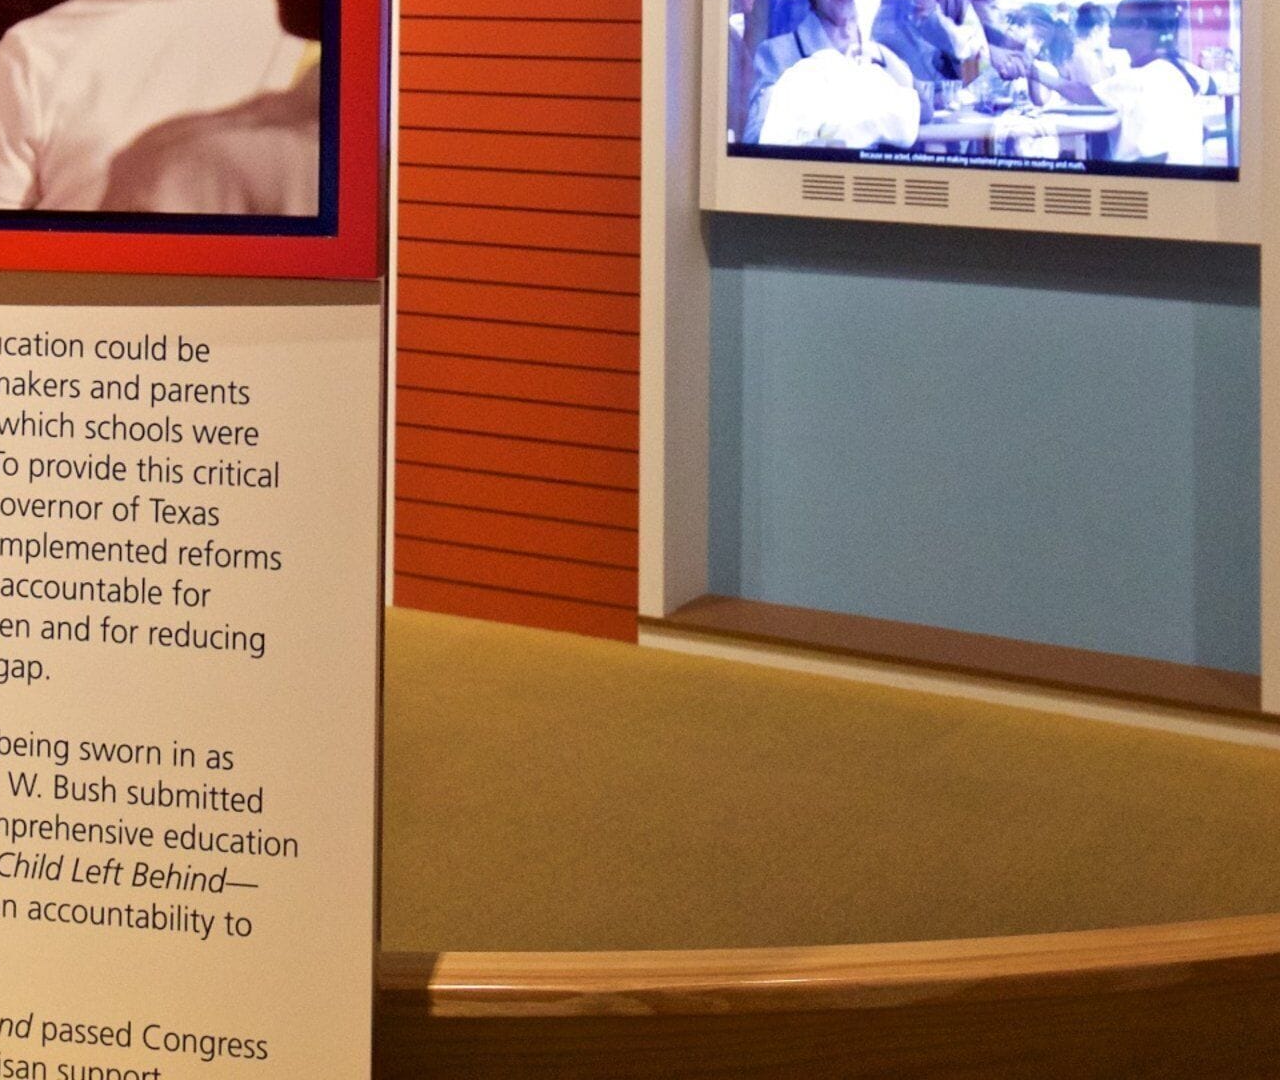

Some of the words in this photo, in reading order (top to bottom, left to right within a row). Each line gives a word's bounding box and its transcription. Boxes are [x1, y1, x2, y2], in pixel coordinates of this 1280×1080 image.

[93, 333, 167, 362] could
[177, 334, 211, 364] be
[89, 373, 140, 401] and
[150, 380, 251, 409] parents
[84, 412, 184, 444] schools
[191, 424, 260, 447] were
[28, 453, 128, 485] provide
[135, 455, 184, 485] this
[192, 458, 280, 489] critical
[111, 494, 141, 523] of
[148, 497, 220, 527] Texas
